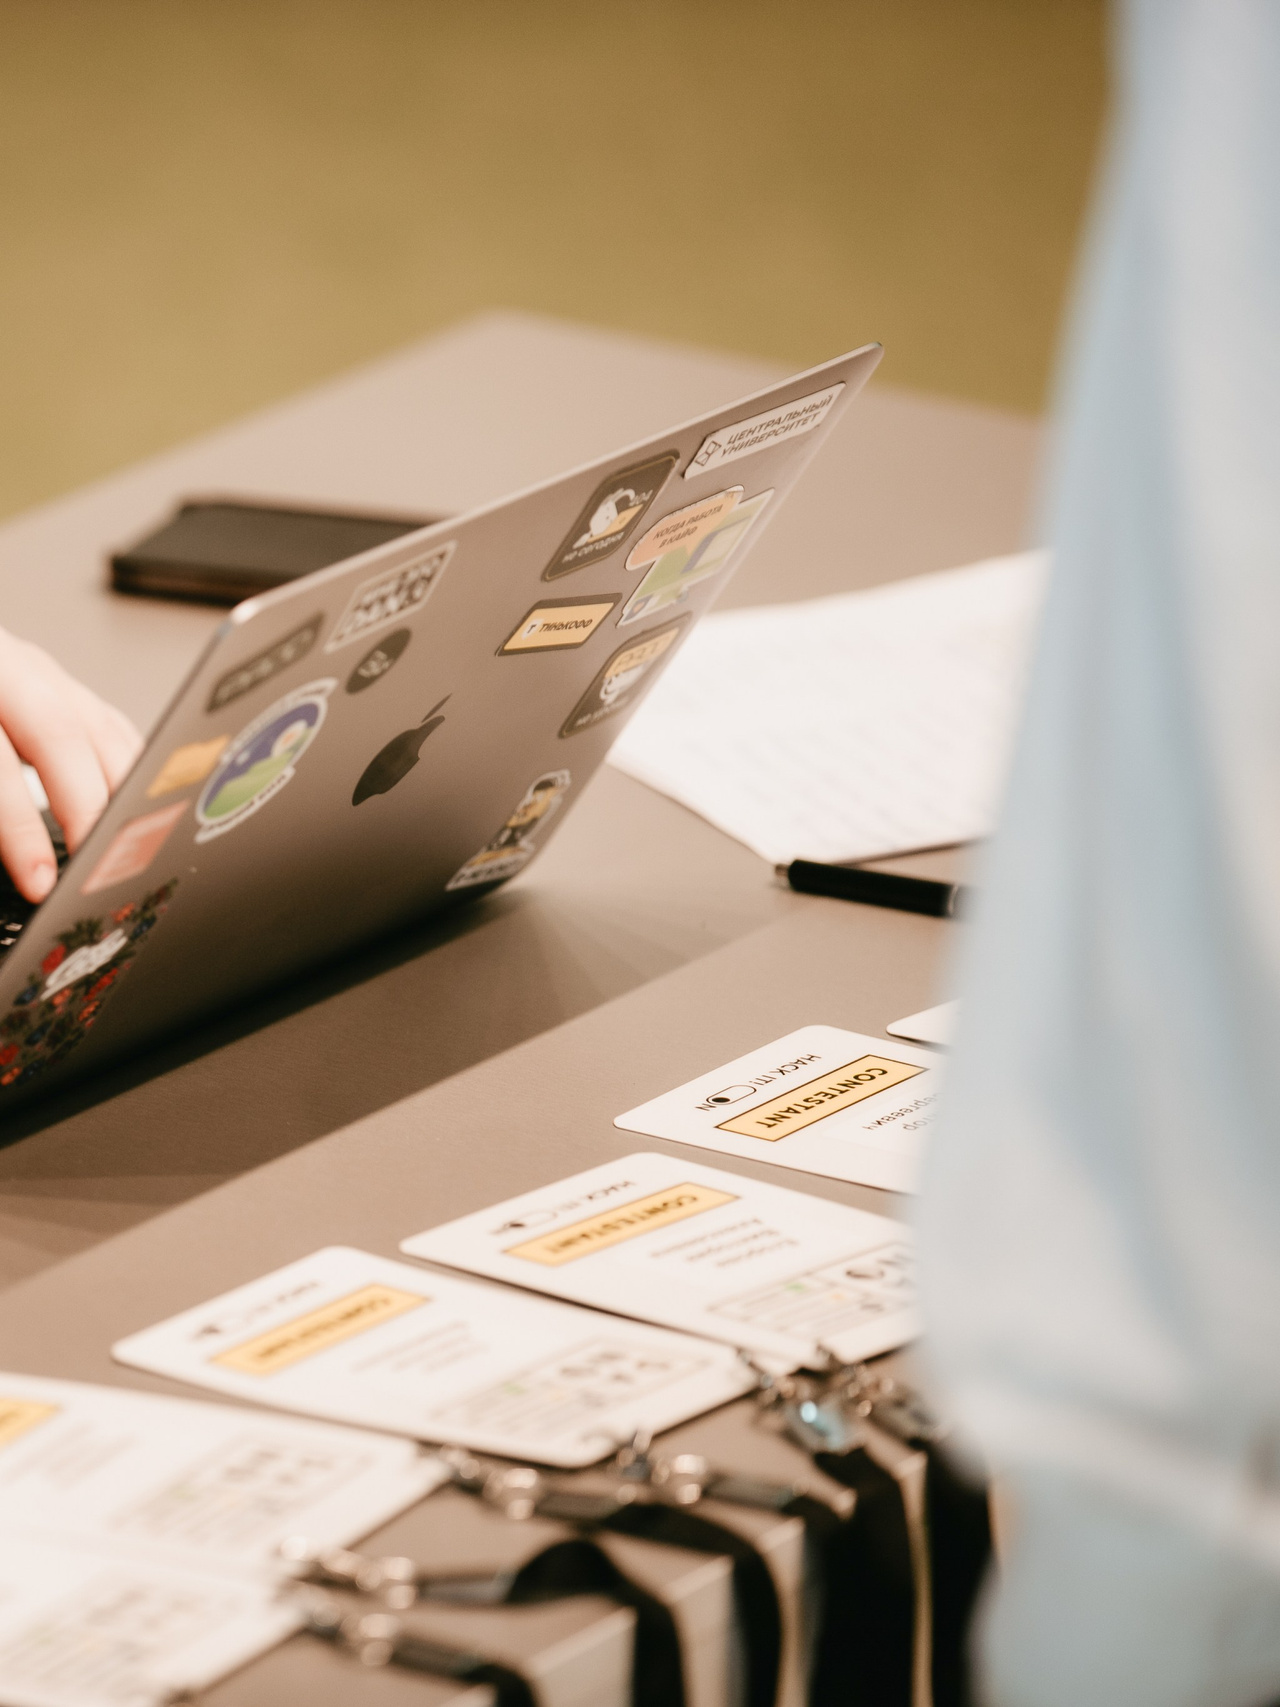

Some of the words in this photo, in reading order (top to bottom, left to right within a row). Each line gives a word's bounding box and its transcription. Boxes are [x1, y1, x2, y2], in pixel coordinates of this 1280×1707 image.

[720, 411, 820, 457] УНИВЕРСИТЕТ
[728, 394, 833, 445] ЦЕНТРАЛЬНЫЙ
[539, 619, 593, 632] ТИНЬКОФФ
[769, 1054, 821, 1076] HACK
[756, 1068, 888, 1128] CONTESTANT
